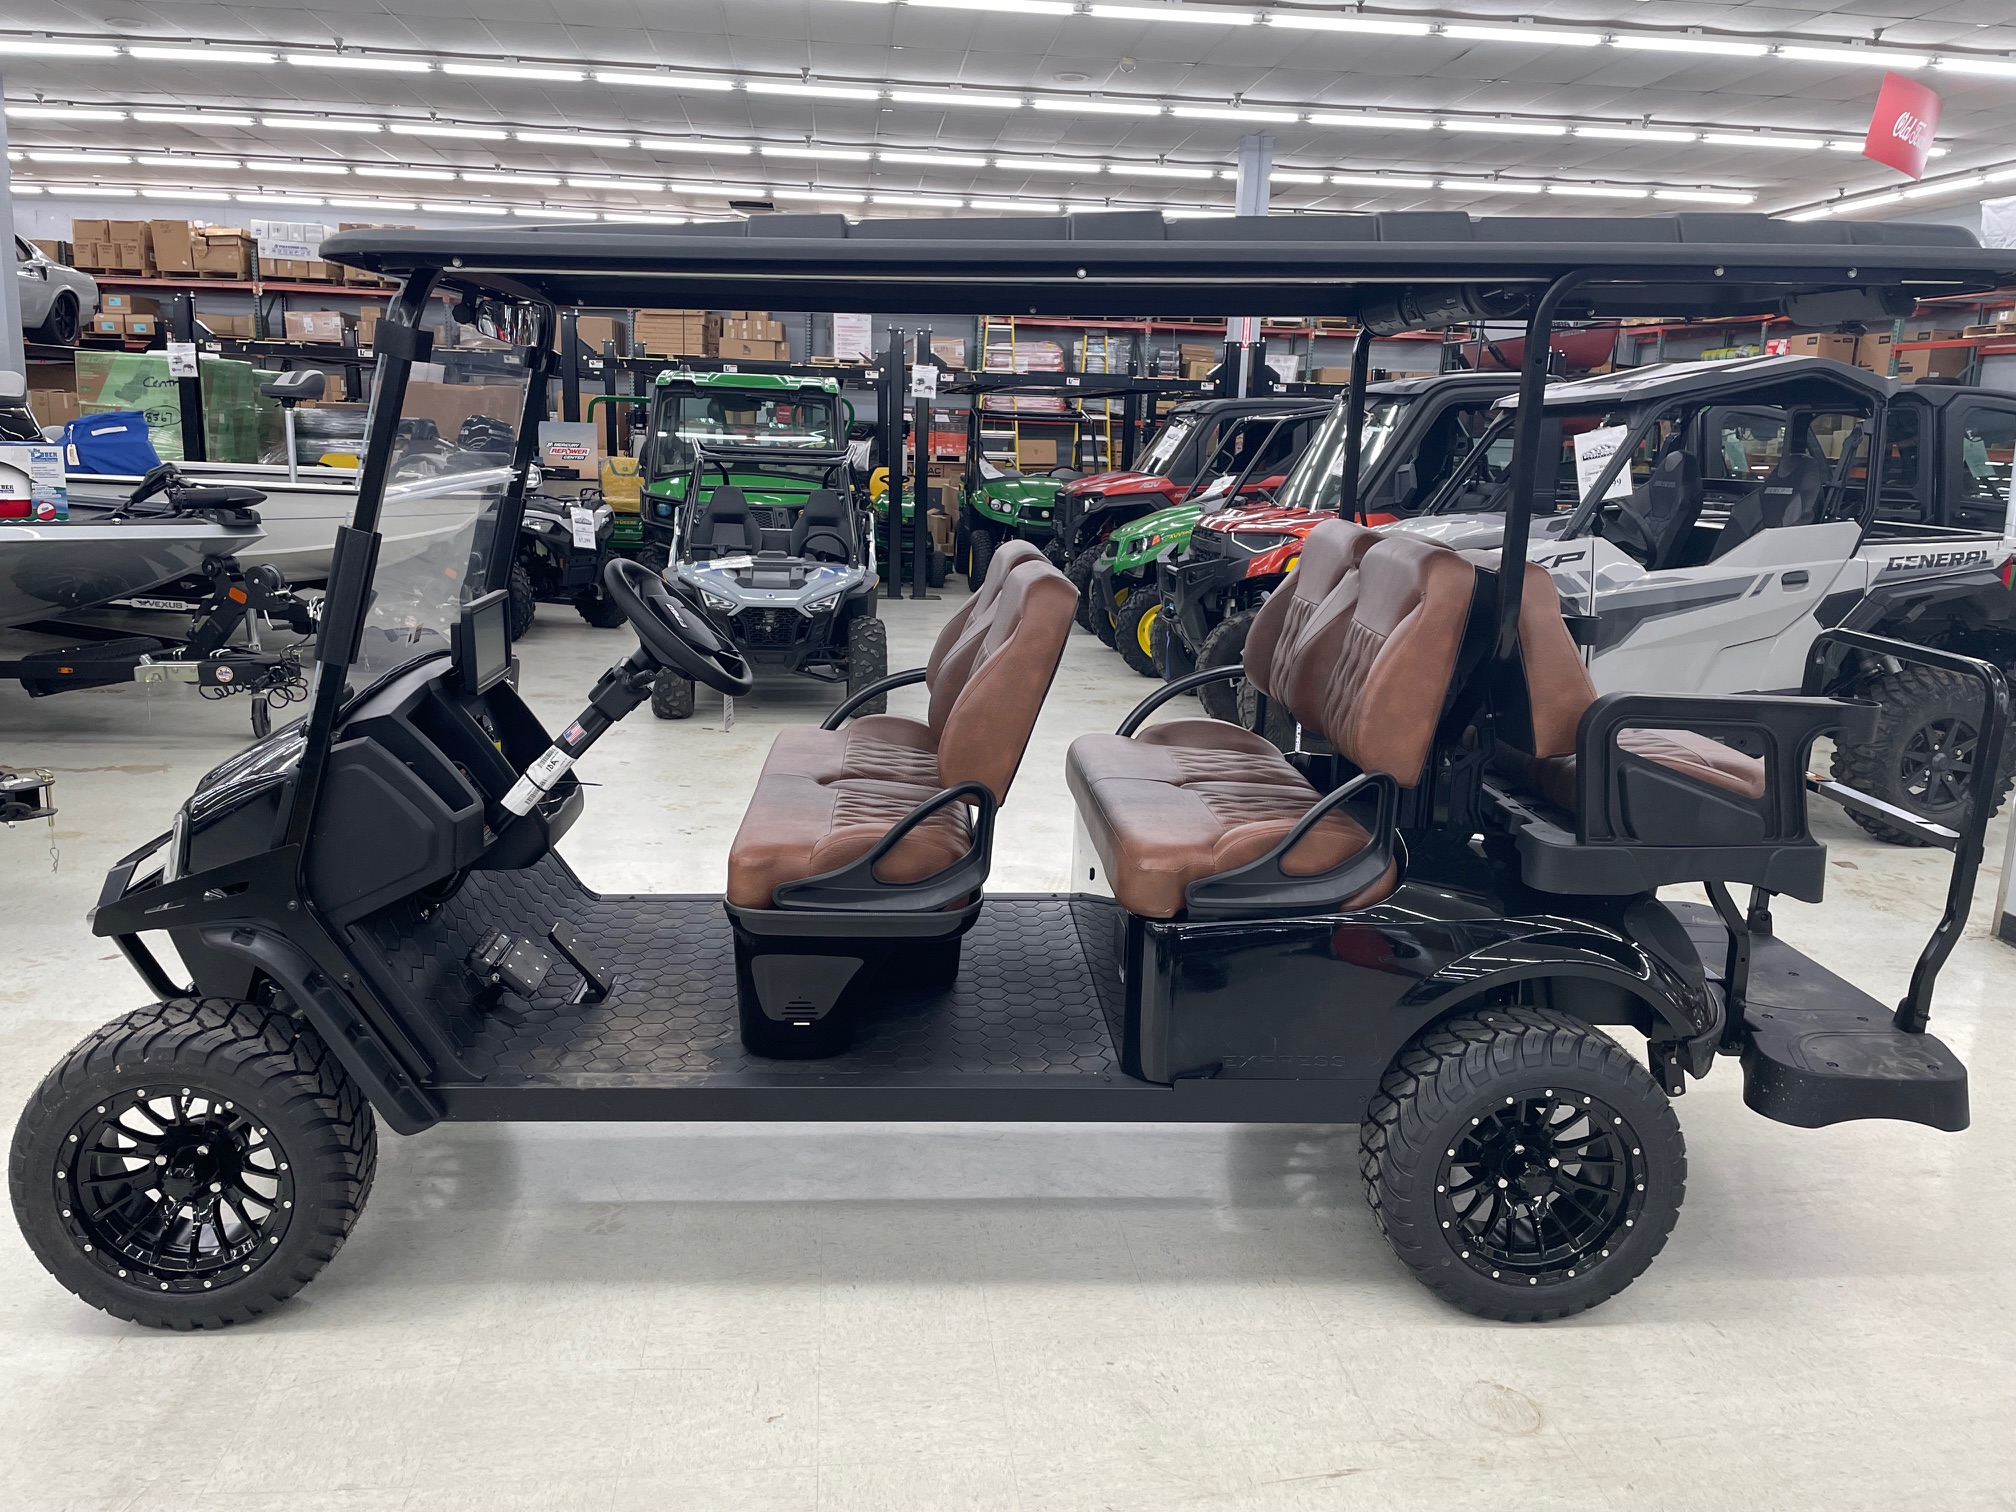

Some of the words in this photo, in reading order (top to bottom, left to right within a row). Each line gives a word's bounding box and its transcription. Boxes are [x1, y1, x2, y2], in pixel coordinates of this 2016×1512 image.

[1886, 550, 1992, 571] GENERAL
[149, 600, 183, 609] VEXUS
[1222, 1055, 1346, 1069] EXPRESS
